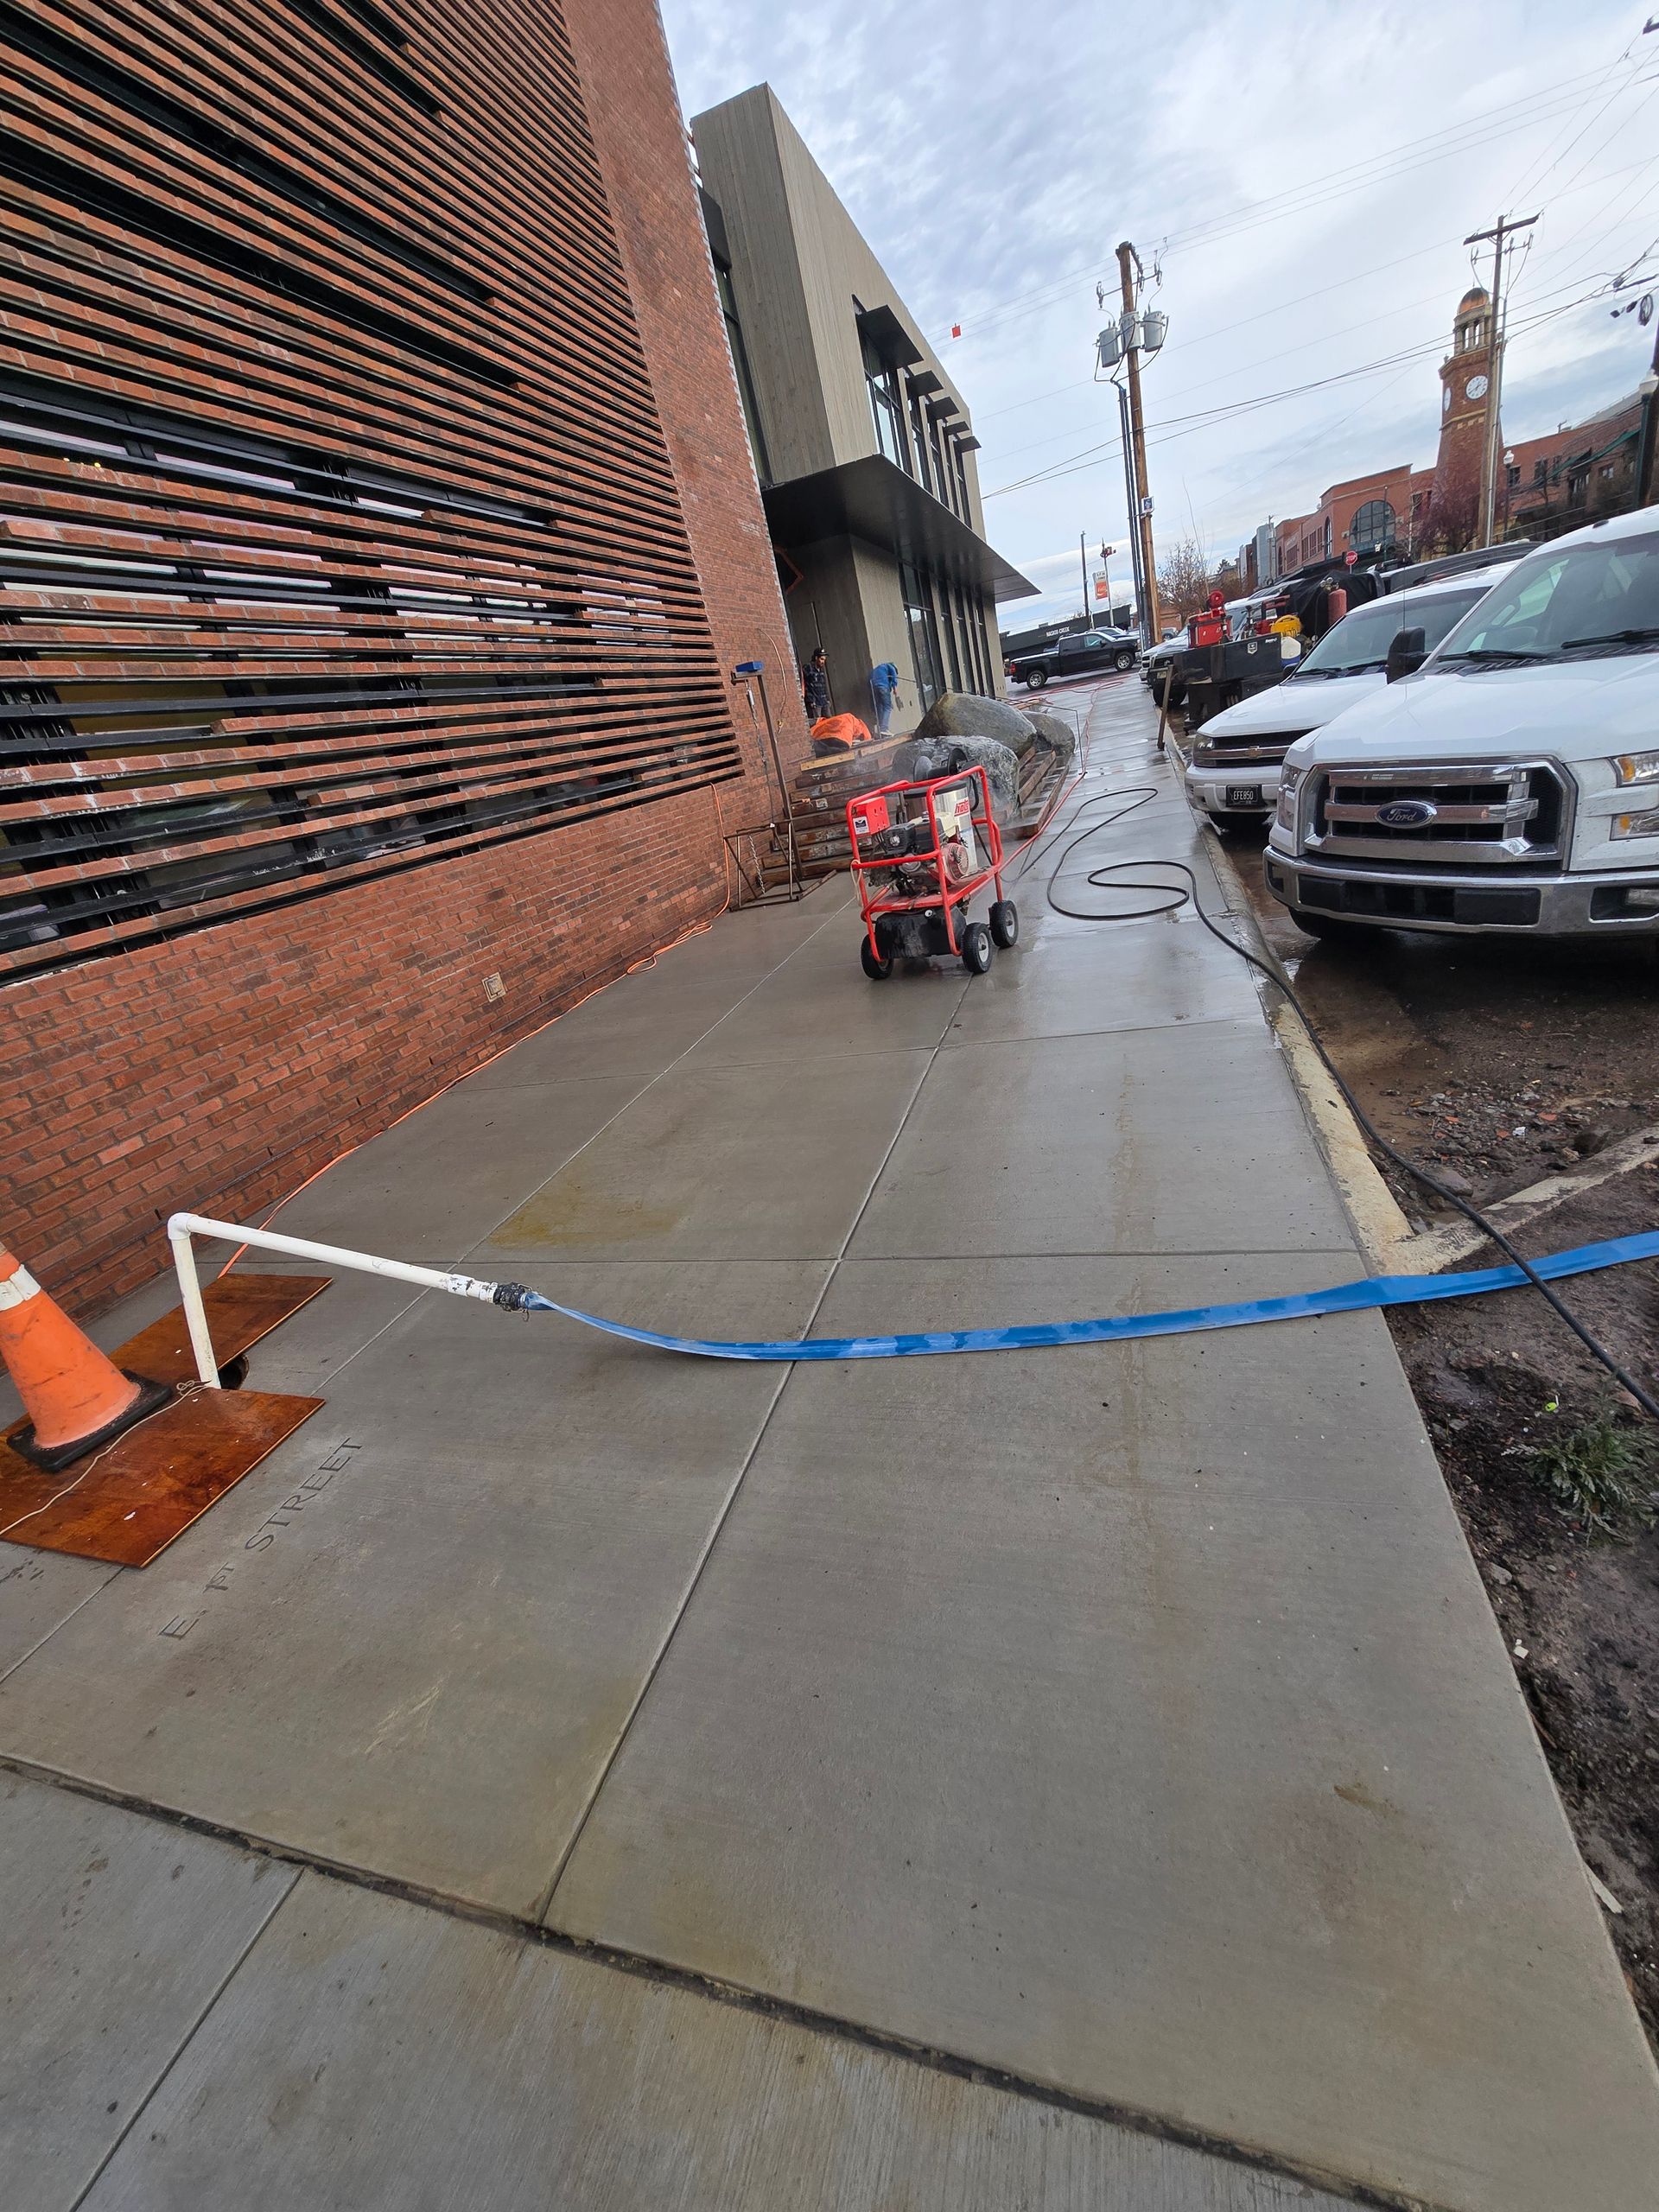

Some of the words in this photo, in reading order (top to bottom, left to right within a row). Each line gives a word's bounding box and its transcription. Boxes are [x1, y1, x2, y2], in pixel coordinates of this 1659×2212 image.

[1234, 791, 1254, 800] EFE850
[1387, 808, 1417, 822] Ford
[202, 1562, 234, 1593] 1ST
[245, 1437, 362, 1552] STREET
